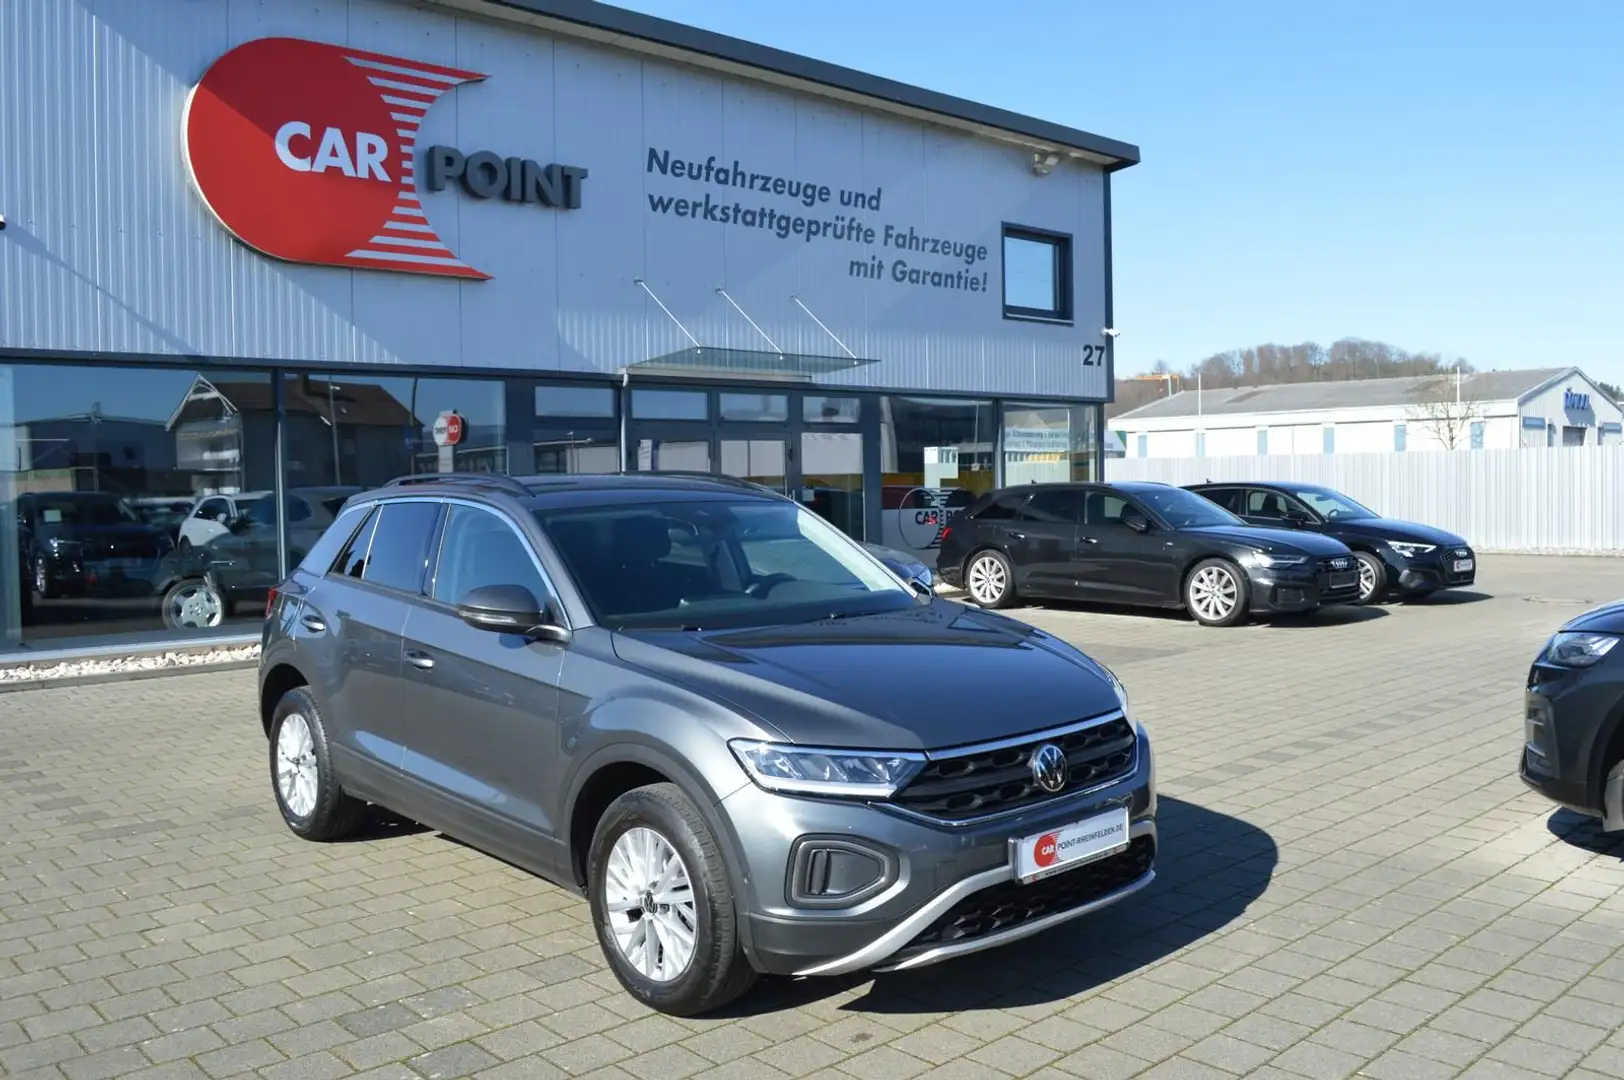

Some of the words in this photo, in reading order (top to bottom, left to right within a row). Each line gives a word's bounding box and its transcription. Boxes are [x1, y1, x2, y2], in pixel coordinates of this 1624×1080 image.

[275, 121, 392, 182] CAR
[427, 144, 589, 209] POINT
[646, 147, 831, 208] Neufahrzeuge
[839, 187, 882, 211] und
[648, 193, 875, 243] werkstattgeprüfte
[883, 225, 988, 265] Fahrzeuge
[848, 255, 884, 280] mit
[891, 259, 988, 293] Garantie!
[1083, 344, 1105, 367] 27
[915, 511, 939, 525] CAR
[1041, 844, 1055, 856] CAR
[1057, 823, 1124, 851] POINT-RHEINFELDEN.DE
